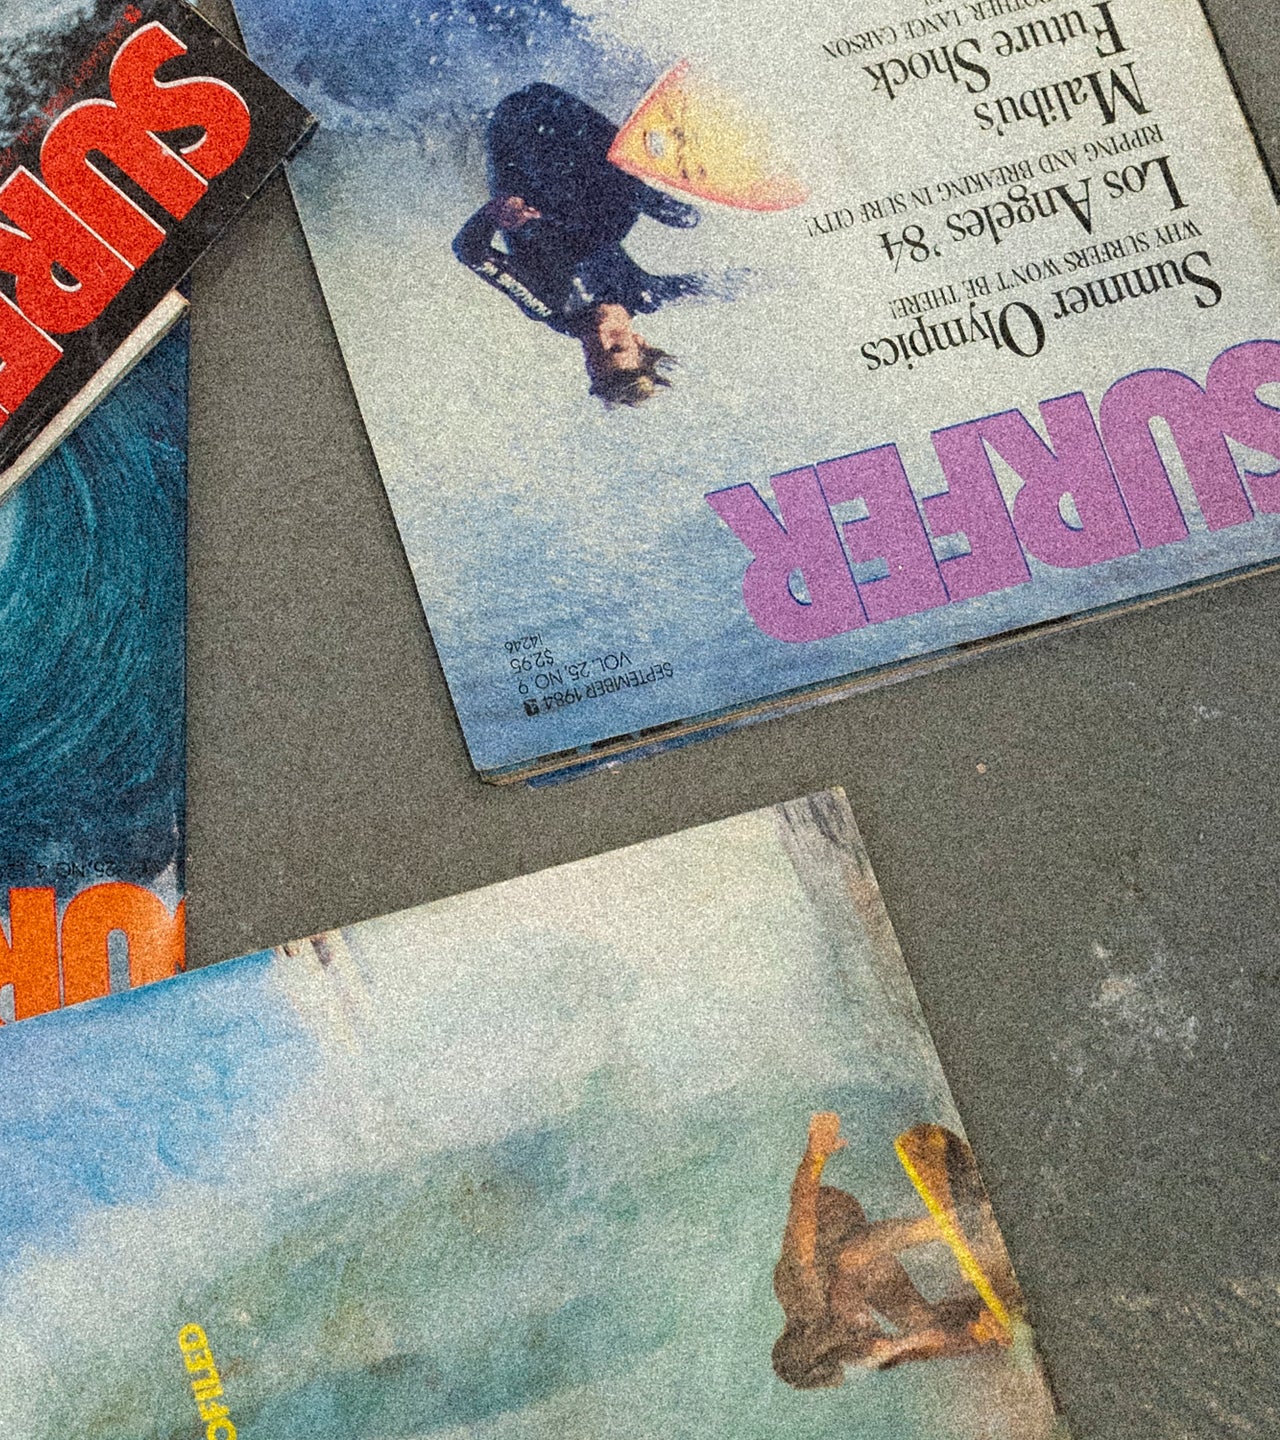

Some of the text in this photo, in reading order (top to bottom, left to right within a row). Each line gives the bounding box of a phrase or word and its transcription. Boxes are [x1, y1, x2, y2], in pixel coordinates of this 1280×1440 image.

[819, 23, 899, 62] CARSON
[864, 1, 1126, 100] Future Shock
[899, 6, 961, 41] LANCE
[974, 62, 1149, 127] Malibu's
[803, 122, 1164, 238] RIPPING AND BREAKING IN SURF CITY!
[877, 156, 1186, 274] Los Angeles '84
[886, 220, 1203, 320] WHY SURFERS WON'T BE THERE!
[861, 250, 1222, 366] Summer Olympics
[704, 339, 1280, 644] SURFER
[503, 633, 543, 655] 14246
[509, 648, 554, 674] $2.95
[563, 660, 591, 682] 25,
[515, 678, 529, 696] 9
[541, 661, 674, 711] SEPTEMBER 1984
